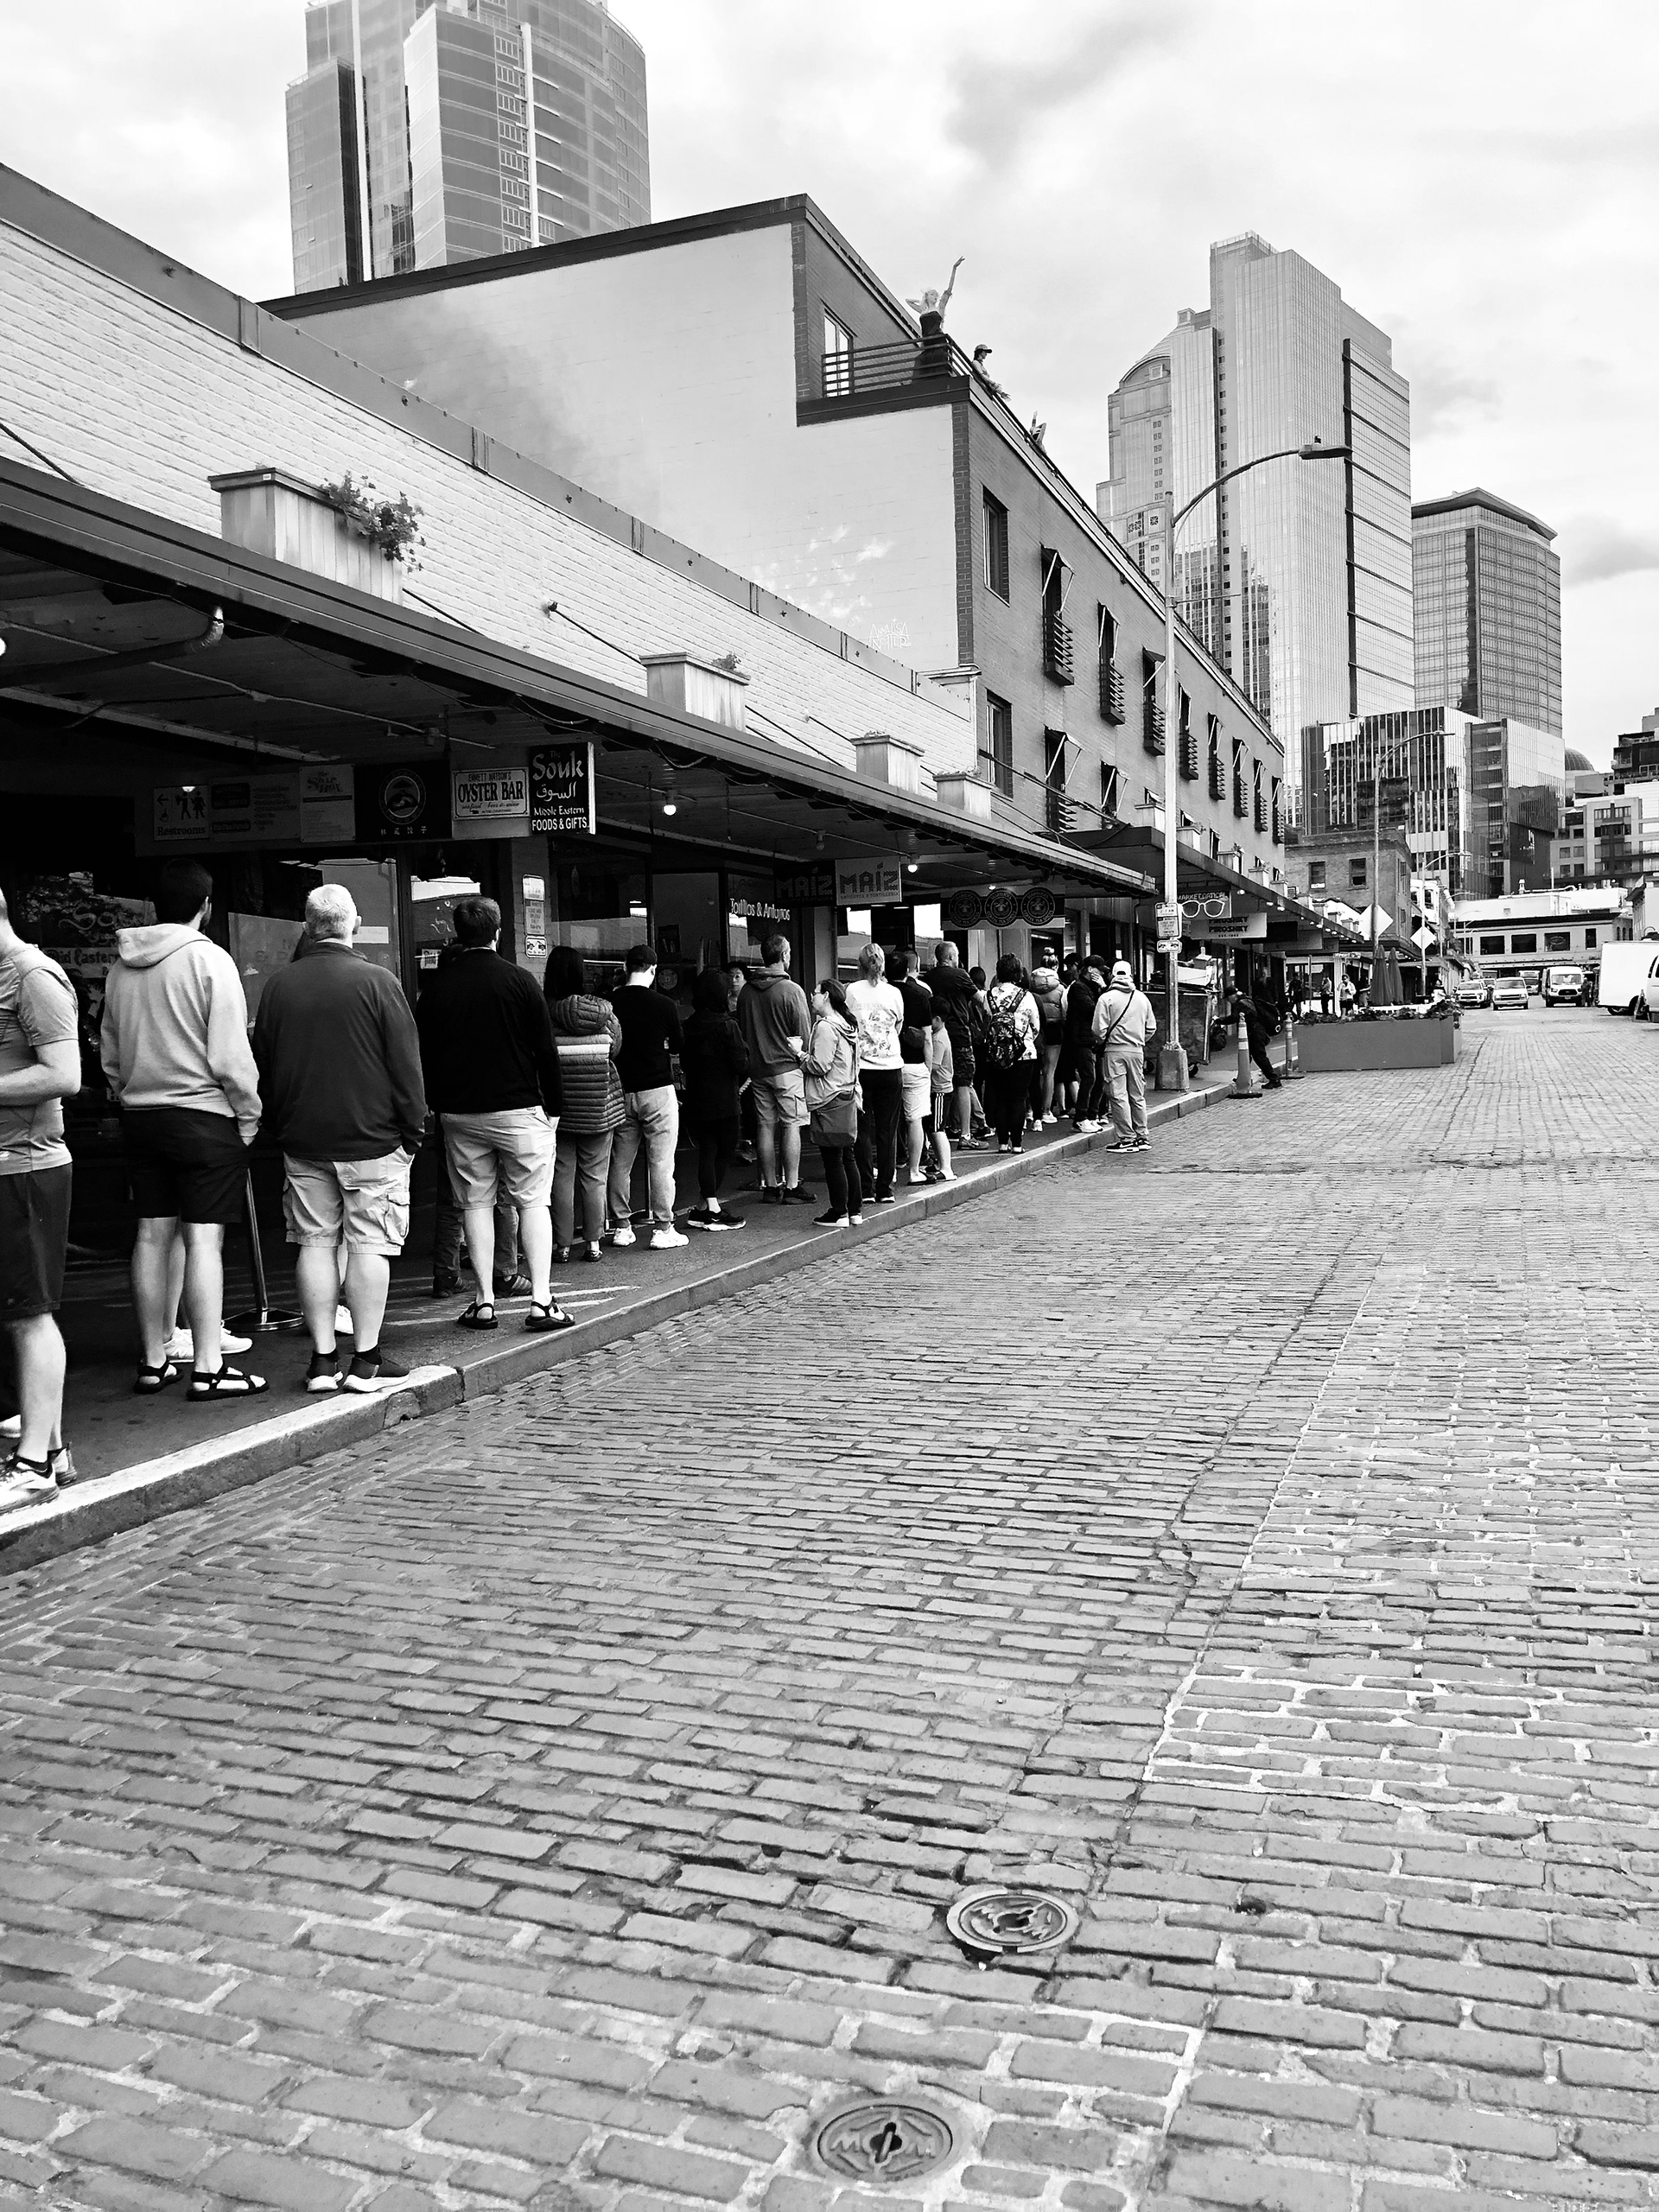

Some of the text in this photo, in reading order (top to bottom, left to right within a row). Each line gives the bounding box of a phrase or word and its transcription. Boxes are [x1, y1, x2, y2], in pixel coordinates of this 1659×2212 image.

[532, 750, 585, 781] Souk
[458, 781, 524, 803] OYSTER BAR
[536, 781, 577, 802] السوق
[534, 804, 585, 817] Middle Eastern
[157, 826, 206, 836] Restrooms
[531, 817, 588, 831] FOODS & GIFTS
[839, 861, 898, 894] MAÍZ
[756, 901, 763, 917] &
[1209, 925, 1249, 933] PIROSHKY
